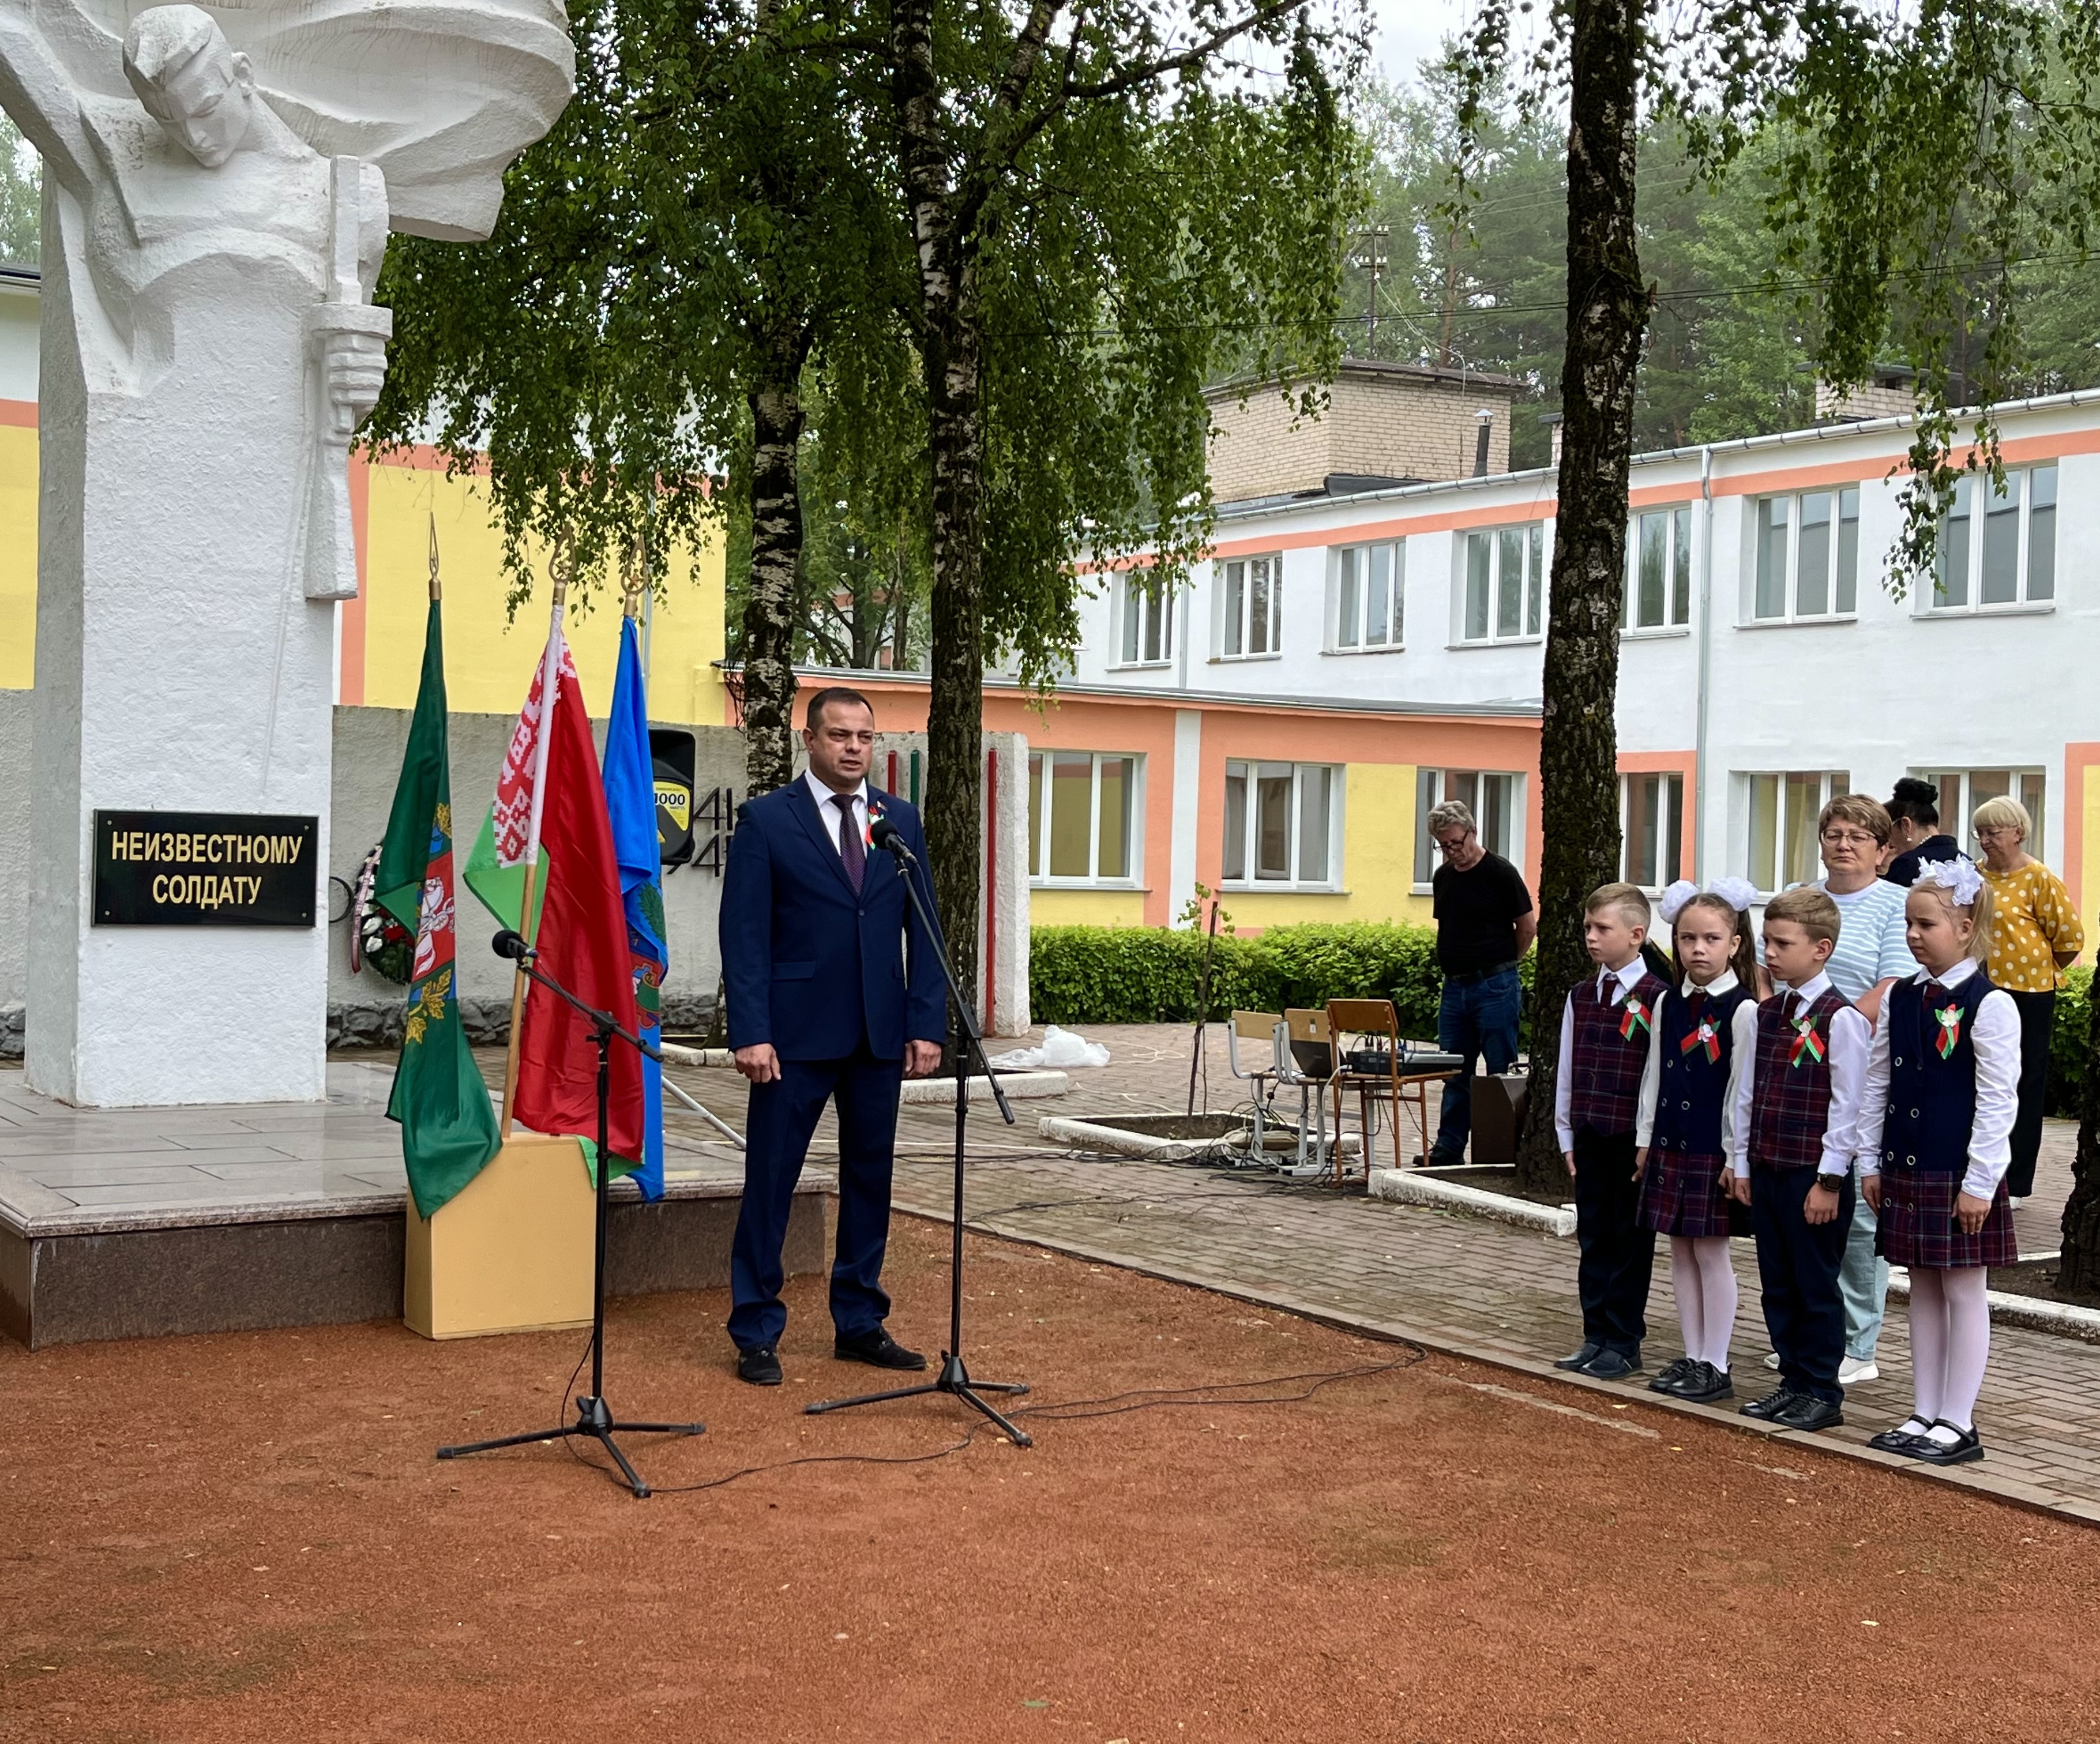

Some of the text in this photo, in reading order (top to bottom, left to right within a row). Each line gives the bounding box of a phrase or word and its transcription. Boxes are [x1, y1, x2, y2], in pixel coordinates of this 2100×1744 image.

[654, 793, 685, 806] 1000
[112, 831, 302, 864] НЕИЗВЕСТНОМУ
[152, 874, 262, 909] СОЛДАТУ
